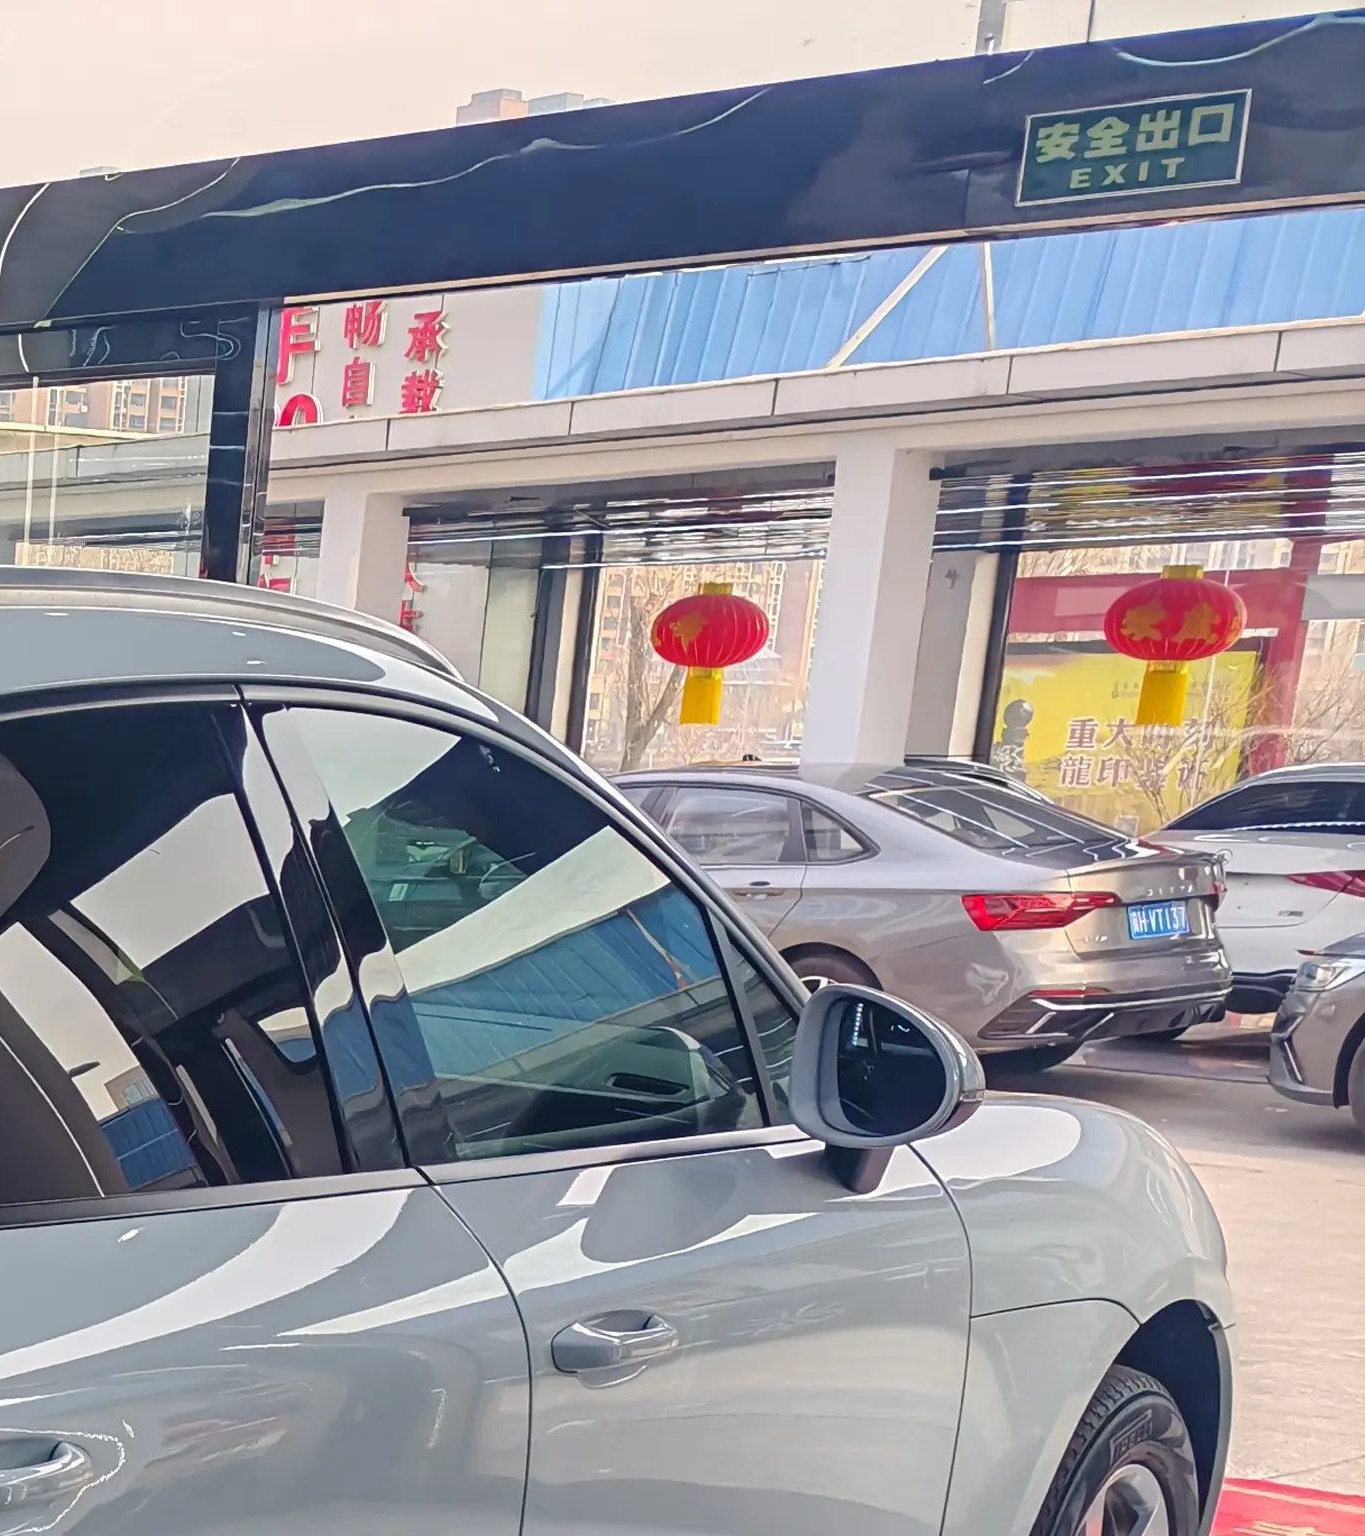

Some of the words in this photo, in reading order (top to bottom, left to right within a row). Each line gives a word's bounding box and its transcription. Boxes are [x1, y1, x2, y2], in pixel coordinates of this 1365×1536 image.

[1036, 103, 1235, 163] 安全出口
[1070, 157, 1185, 189] EXIT
